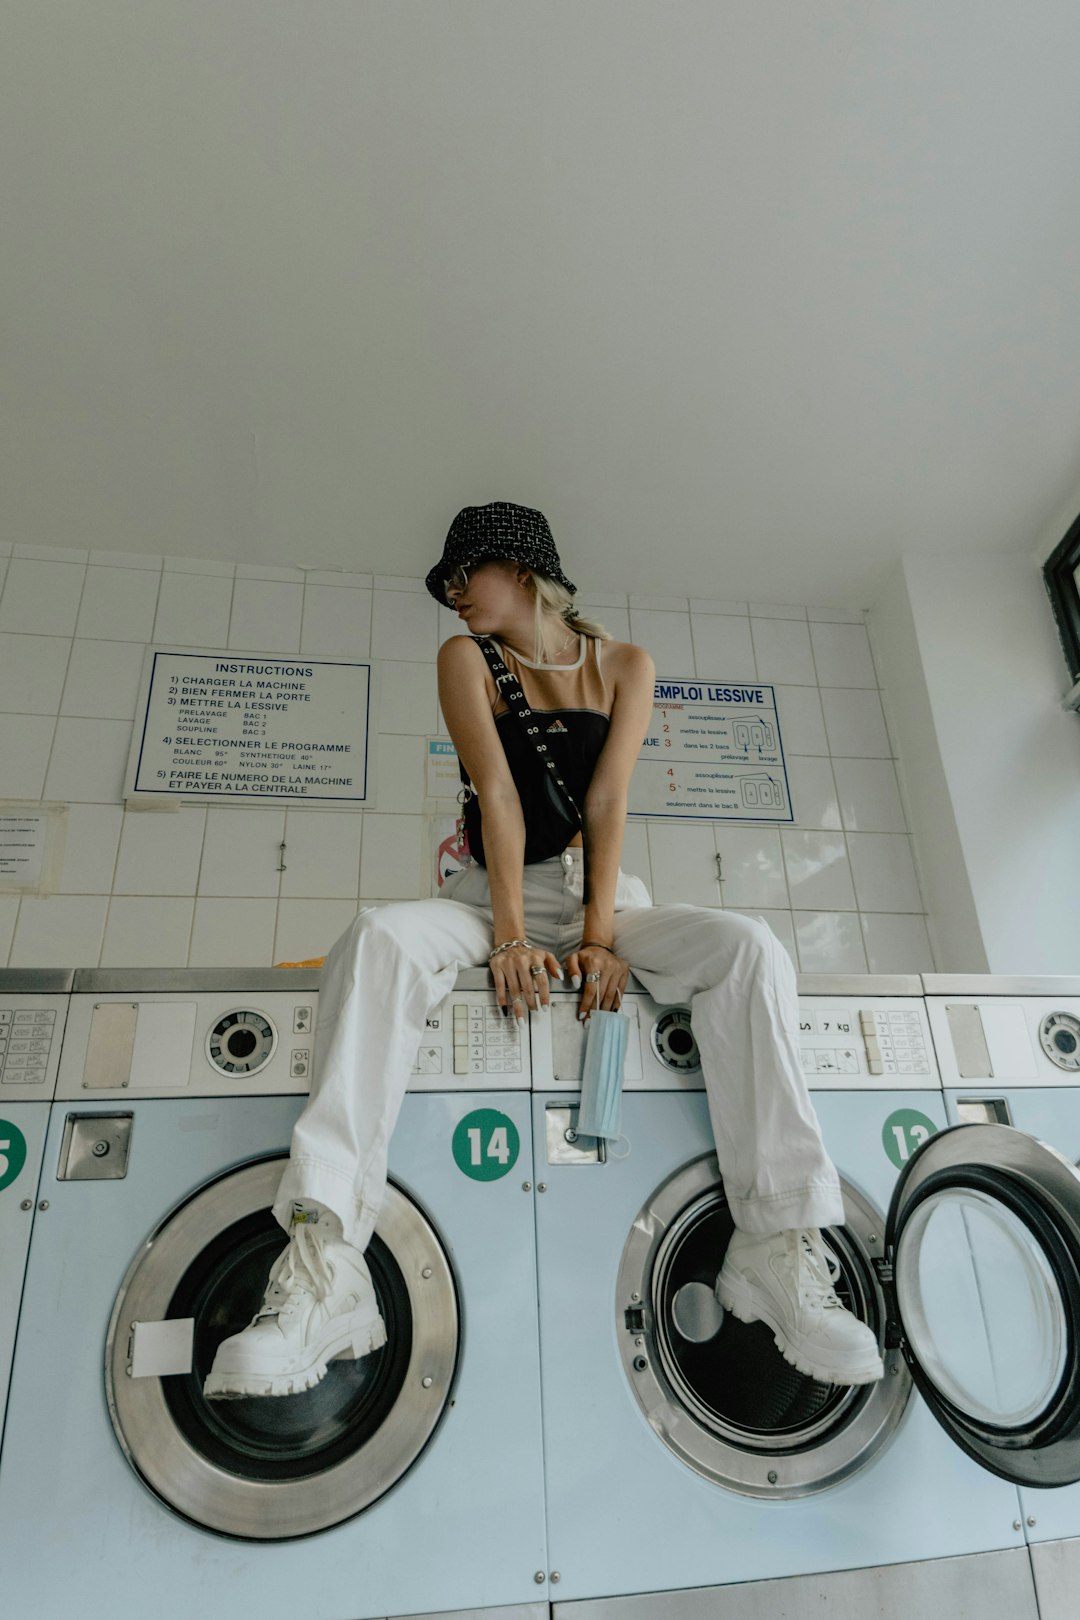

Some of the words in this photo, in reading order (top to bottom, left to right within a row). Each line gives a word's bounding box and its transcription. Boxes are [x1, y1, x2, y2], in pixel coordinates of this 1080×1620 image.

[215, 663, 313, 677] INSTRUCTIONS
[170, 676, 179, 685] 1)
[182, 676, 236, 687] CHARGER
[239, 680, 252, 688] LA
[256, 681, 306, 691] MACHINE
[168, 686, 178, 695] 2)
[181, 687, 207, 696] BIEN
[211, 689, 256, 698] FERMER
[260, 692, 273, 700] LA
[276, 692, 311, 702] PORTE
[653, 685, 703, 700] EMPLOI
[708, 688, 764, 703] LESSIVE
[167, 697, 176, 706] 3)
[180, 698, 224, 708] METTRE
[227, 701, 241, 709] LA
[245, 702, 288, 711] LESSIVE
[653, 703, 684, 711] ROGRAMME
[179, 708, 228, 718] PRELAVAGE
[662, 711, 667, 719] 1
[178, 717, 211, 725] LAVAGE
[177, 725, 218, 734] SOUPLINE
[663, 724, 670, 733] 2
[162, 736, 172, 745] 4)
[175, 737, 261, 749] SELECTIONNER
[264, 741, 278, 749] LE
[281, 742, 351, 753] PROGRAMME
[664, 739, 672, 748] 3
[173, 748, 203, 756] BLANC
[240, 751, 296, 760] SYNTHETIQUE
[172, 758, 212, 766] COULEUR
[239, 761, 268, 769] NYLON
[156, 769, 166, 778] 5)
[170, 770, 202, 780] FAIRE
[205, 772, 219, 781] LE
[221, 773, 269, 783] NUMERO
[271, 775, 286, 783] DE
[289, 776, 302, 784] LA
[304, 777, 353, 786] MACHINE
[667, 768, 674, 777] 4
[168, 780, 183, 789] ET
[185, 781, 222, 790] PAYER
[224, 783, 232, 791] A
[235, 783, 248, 791] LA
[251, 784, 308, 794] CENTRALE
[669, 783, 676, 792] 5
[687, 786, 706, 794] mettre
[666, 800, 697, 808] seulement
[698, 801, 713, 809] dans
[425, 1019, 440, 1029] kg
[823, 1023, 830, 1031] 7
[837, 1023, 850, 1032] kg
[467, 1127, 509, 1166] 14
